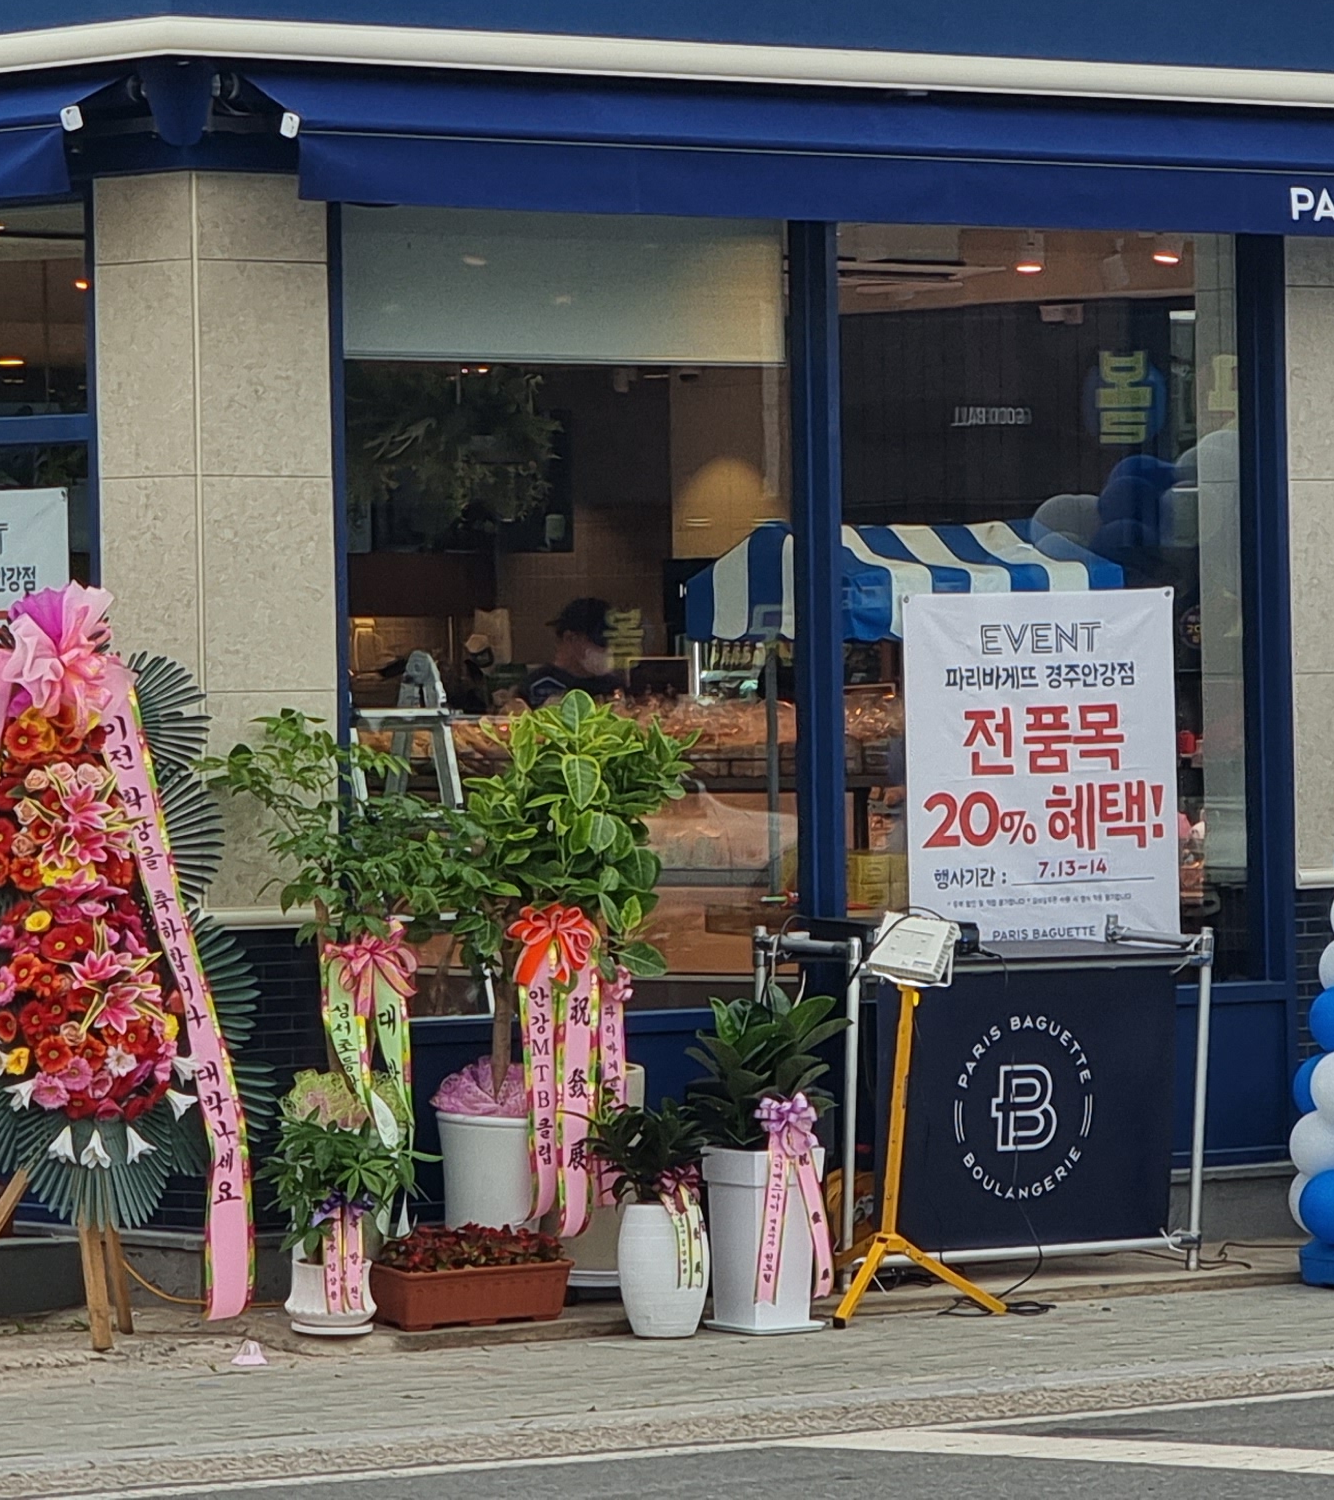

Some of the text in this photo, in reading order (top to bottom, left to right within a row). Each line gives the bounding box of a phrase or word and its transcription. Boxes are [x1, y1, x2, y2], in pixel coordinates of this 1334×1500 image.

[980, 621, 1102, 655] EVENT
[944, 660, 1136, 692] 파리바게뜨 경주안강점
[962, 703, 1125, 777] 전품목
[921, 780, 1165, 850] 20% 혜택!
[933, 867, 997, 891] 행사기간
[1037, 858, 1108, 879] 7.13~14
[104, 715, 134, 771] 이전
[195, 1060, 243, 1205] 대박나세요
[992, 925, 1097, 941] PARIS BAGUETTE
[956, 1014, 1092, 1090] PARIS BAGUETTE
[962, 1145, 1082, 1201] BOULANGERIE
